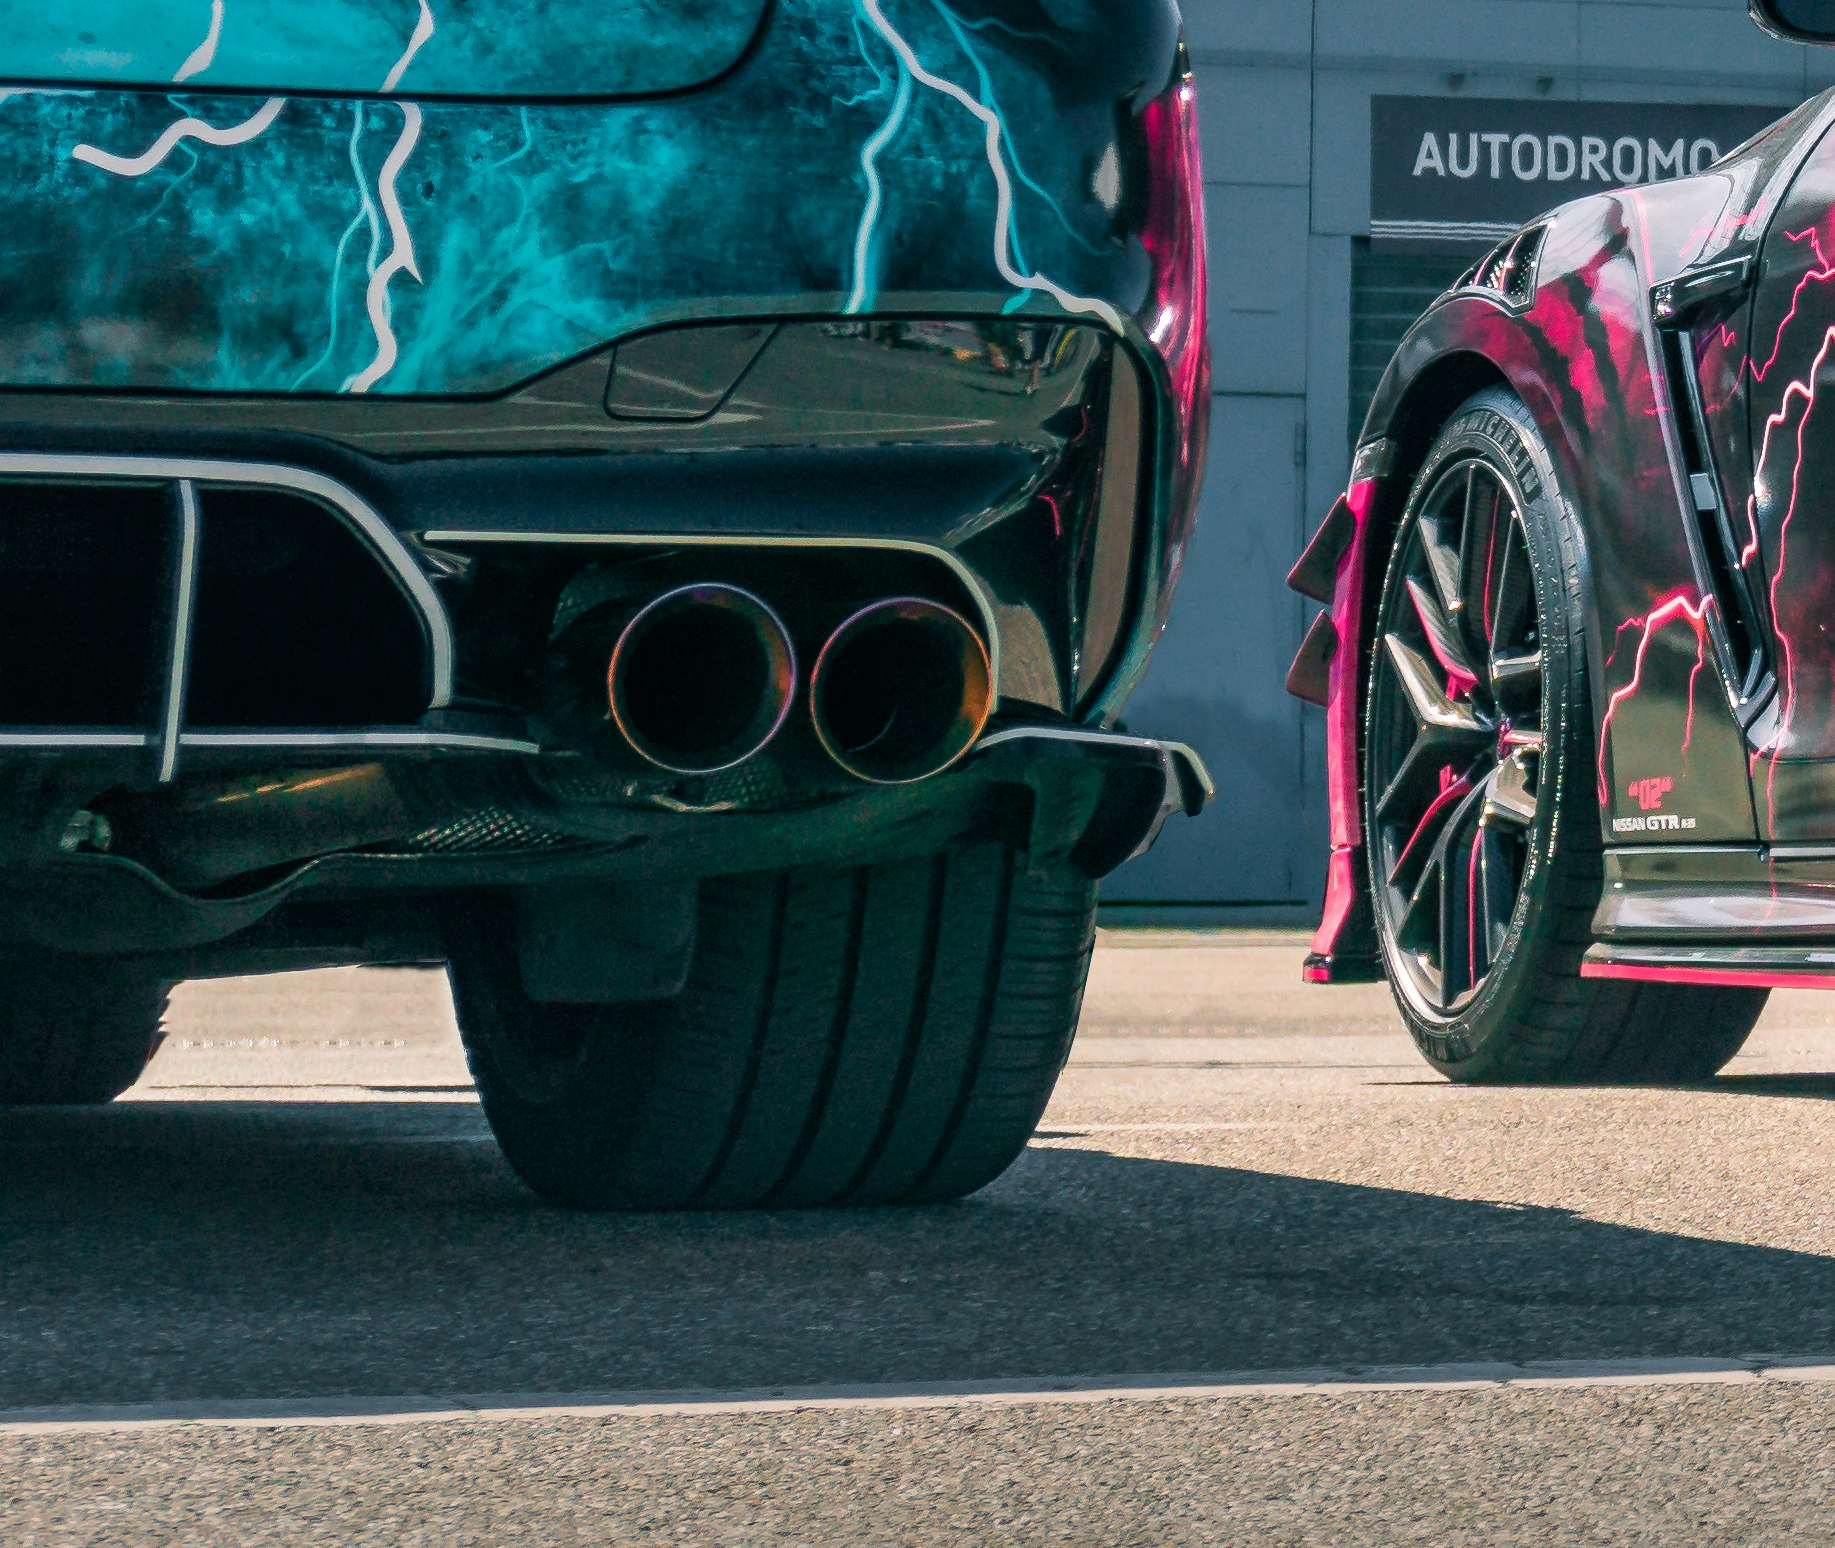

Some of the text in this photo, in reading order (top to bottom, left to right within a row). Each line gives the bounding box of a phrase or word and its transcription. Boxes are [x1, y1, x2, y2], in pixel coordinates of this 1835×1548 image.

[1412, 131, 1720, 185] AUTODROMO
[1612, 817, 1647, 833] NISSAN
[1646, 814, 1681, 830] GTR
